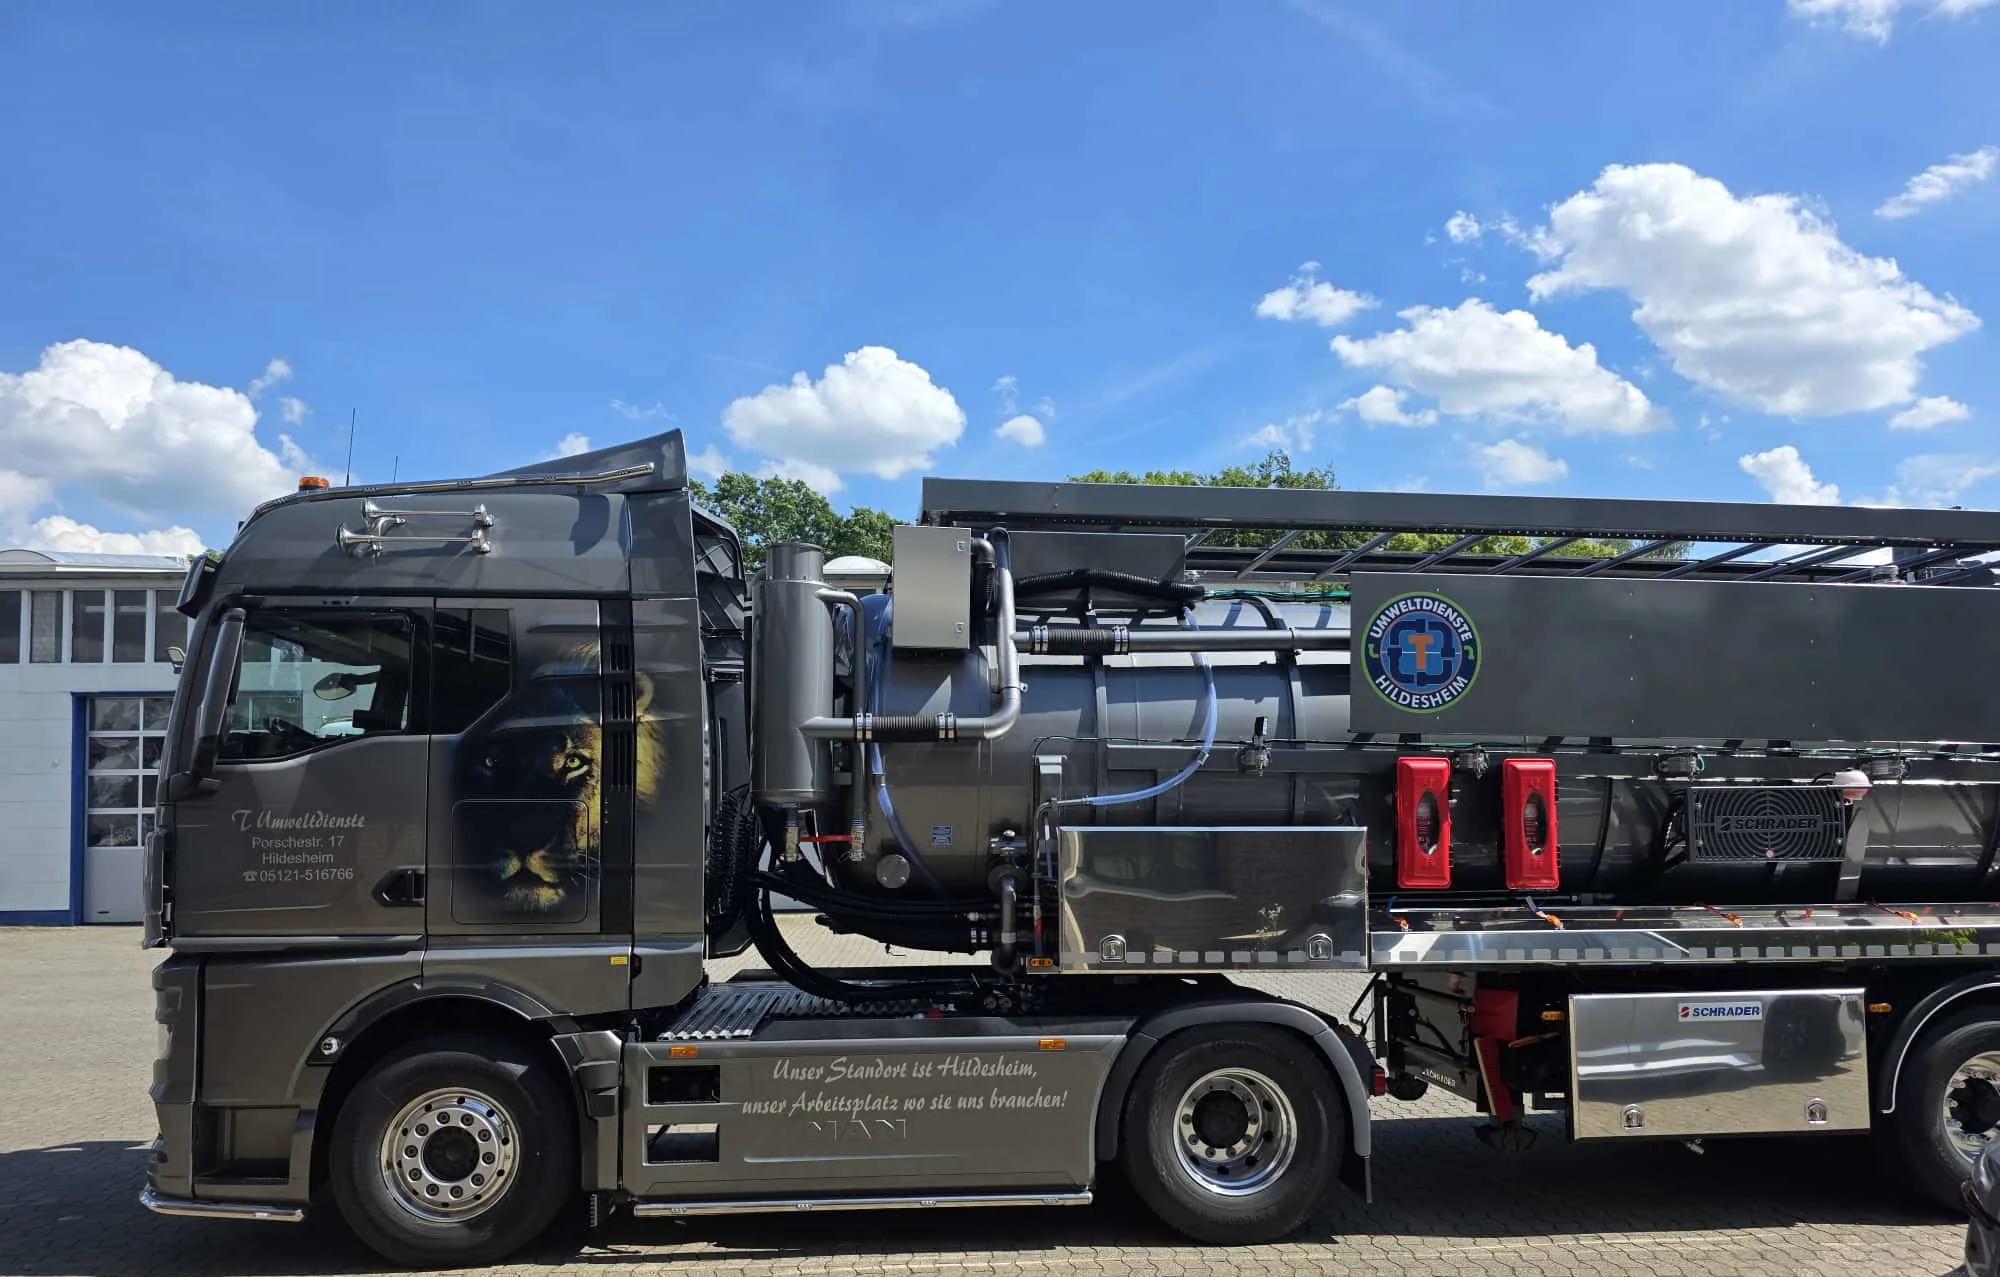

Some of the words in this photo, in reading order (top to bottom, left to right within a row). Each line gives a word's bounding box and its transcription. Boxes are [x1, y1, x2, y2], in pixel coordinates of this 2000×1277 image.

[1370, 598, 1473, 642] UMWELTDIENSTE
[1408, 635, 1434, 671] T
[1375, 674, 1468, 708] HILDESHEIM
[256, 809, 367, 829] Umweltdienste
[1735, 818, 1817, 829] SCHRADER
[251, 835, 324, 849] Porschestr.
[329, 834, 345, 848] 17
[262, 852, 334, 865] Hildesheim
[260, 867, 354, 882] 05121-516766
[1692, 1006, 1760, 1017] SCHRADER
[772, 1058, 824, 1081] Unser
[824, 1056, 907, 1084] Standort
[912, 1061, 933, 1078] ist
[937, 1055, 1037, 1078] Hildesheim,
[741, 1099, 787, 1115] unser
[787, 1090, 899, 1119] Arbeitsplatz
[903, 1097, 925, 1111] wo
[929, 1094, 952, 1110] sie
[957, 1096, 984, 1110] uns
[989, 1086, 1068, 1108] brauchen!
[807, 1119, 906, 1140] MAN
